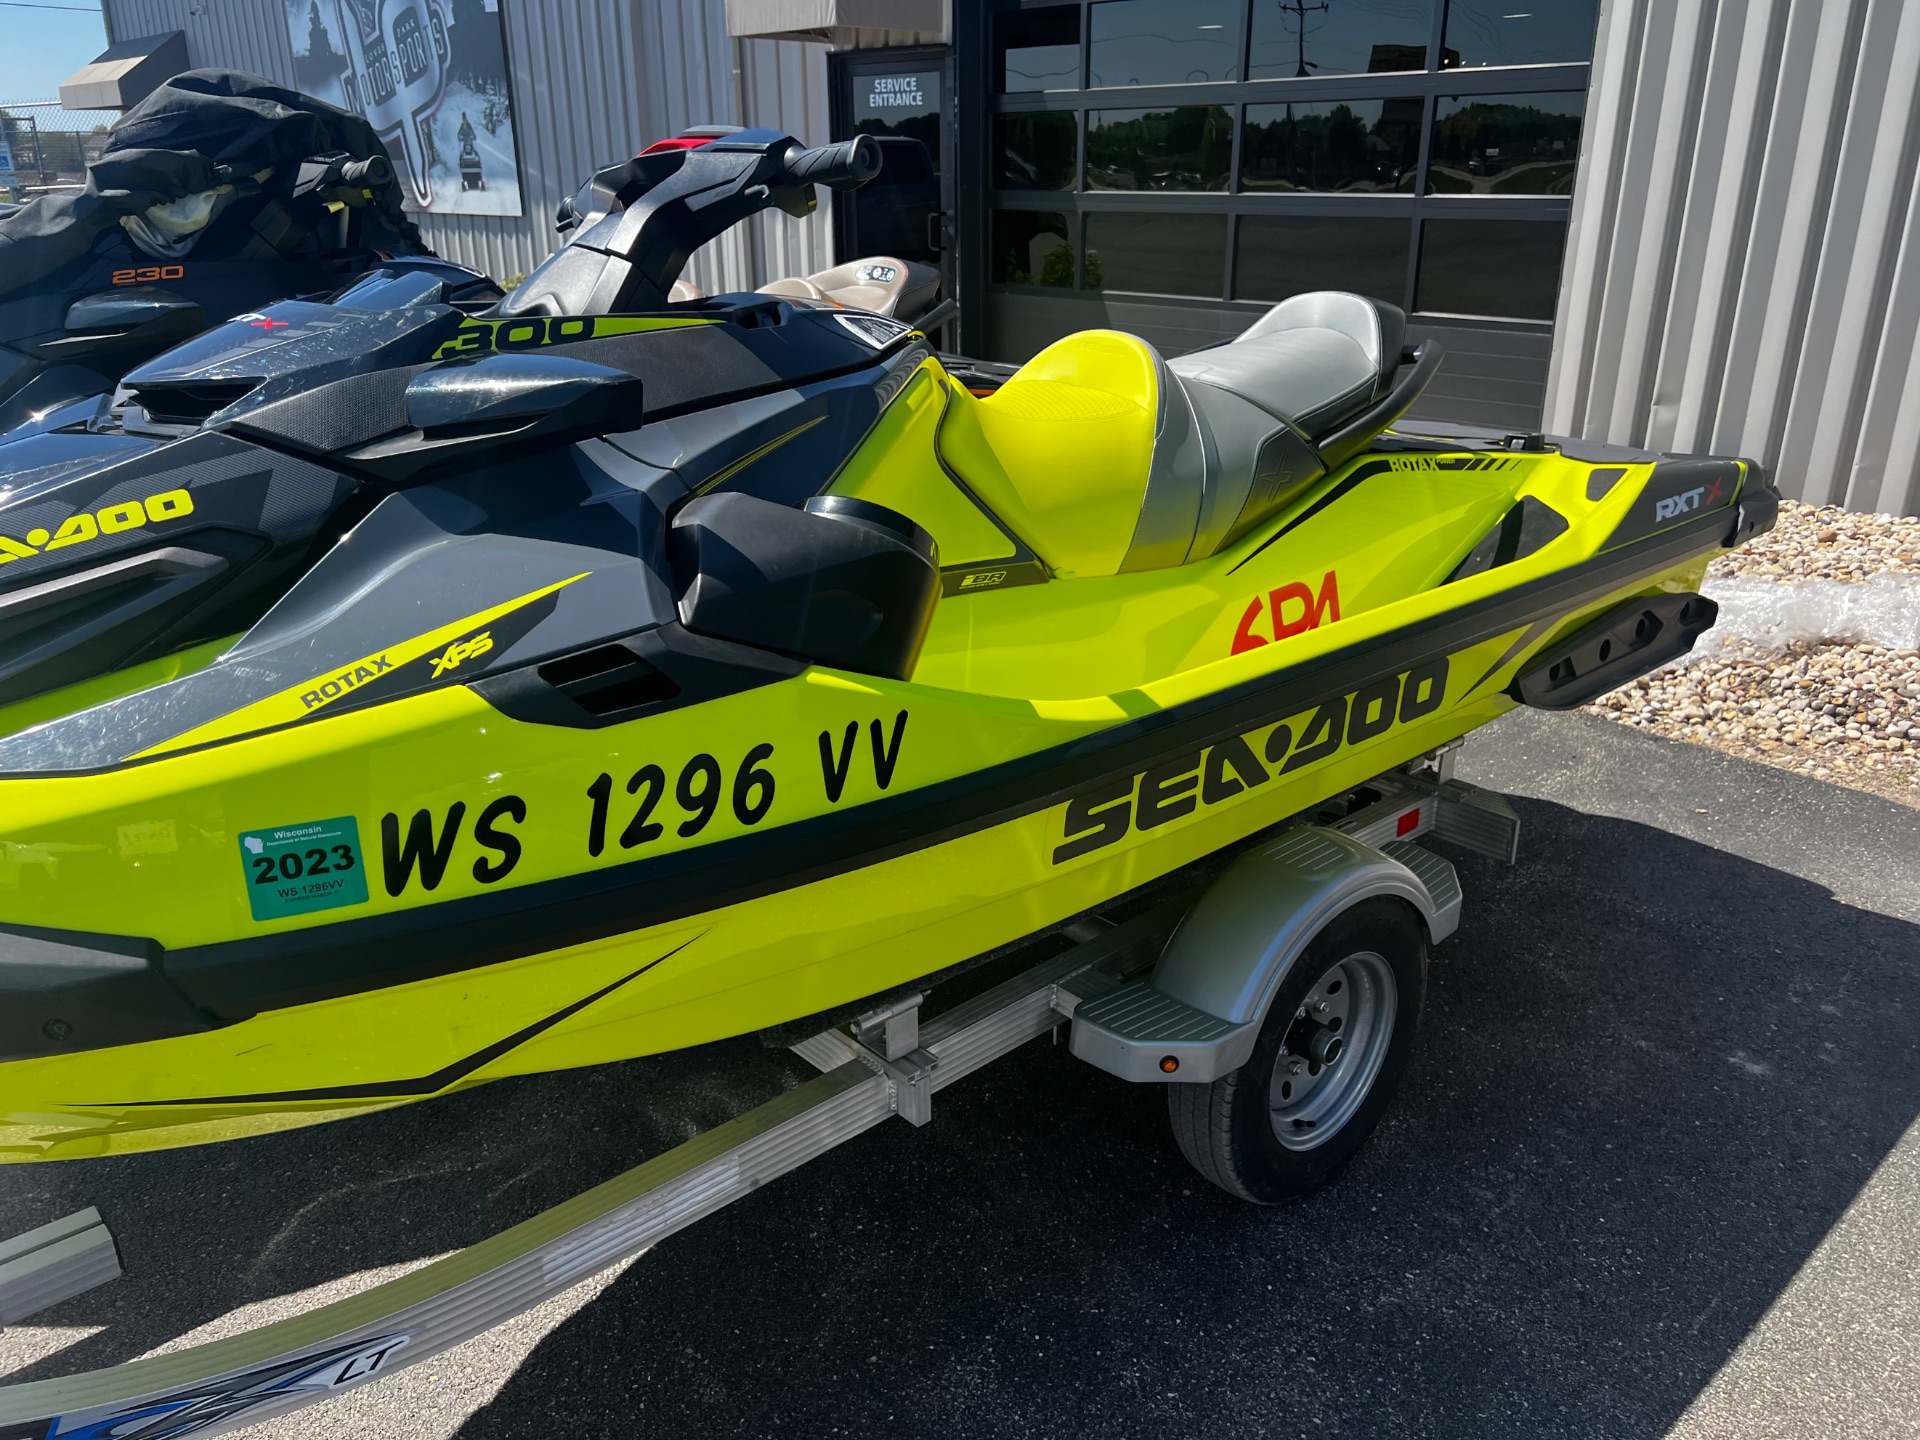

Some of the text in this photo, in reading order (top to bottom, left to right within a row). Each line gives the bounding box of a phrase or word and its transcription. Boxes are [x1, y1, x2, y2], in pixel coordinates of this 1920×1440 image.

[365, 18, 416, 64] LOVES PARK
[346, 17, 444, 114] MOTORSPORTS
[869, 92, 923, 107] ENTRANCE
[874, 77, 917, 92] SERVICE
[112, 265, 184, 285] 230
[444, 317, 595, 358] 300
[1388, 457, 1439, 472] ROTAX
[1655, 486, 1705, 523] RXT
[300, 630, 494, 709] ROTAX XPS
[380, 709, 909, 897] WS 1296 VV
[273, 825, 322, 840] Wisconsin
[252, 844, 355, 885] 2023
[277, 878, 344, 898] WS 1296VV
